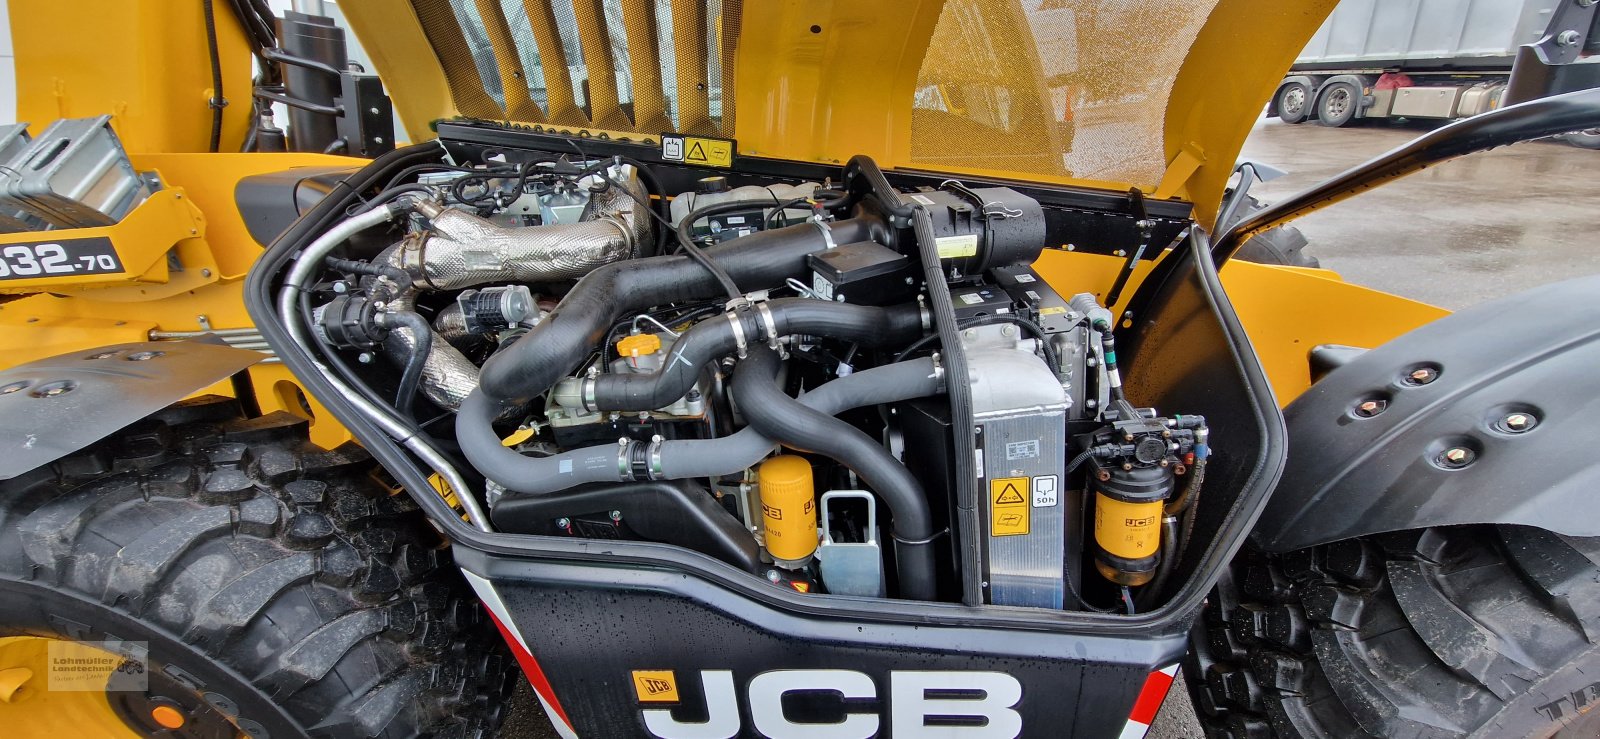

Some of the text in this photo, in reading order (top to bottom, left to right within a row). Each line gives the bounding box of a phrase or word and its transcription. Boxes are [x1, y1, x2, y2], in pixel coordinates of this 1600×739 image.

[1126, 516, 1155, 528] JCB
[644, 679, 670, 694] JCB
[642, 670, 1023, 739] JCB
